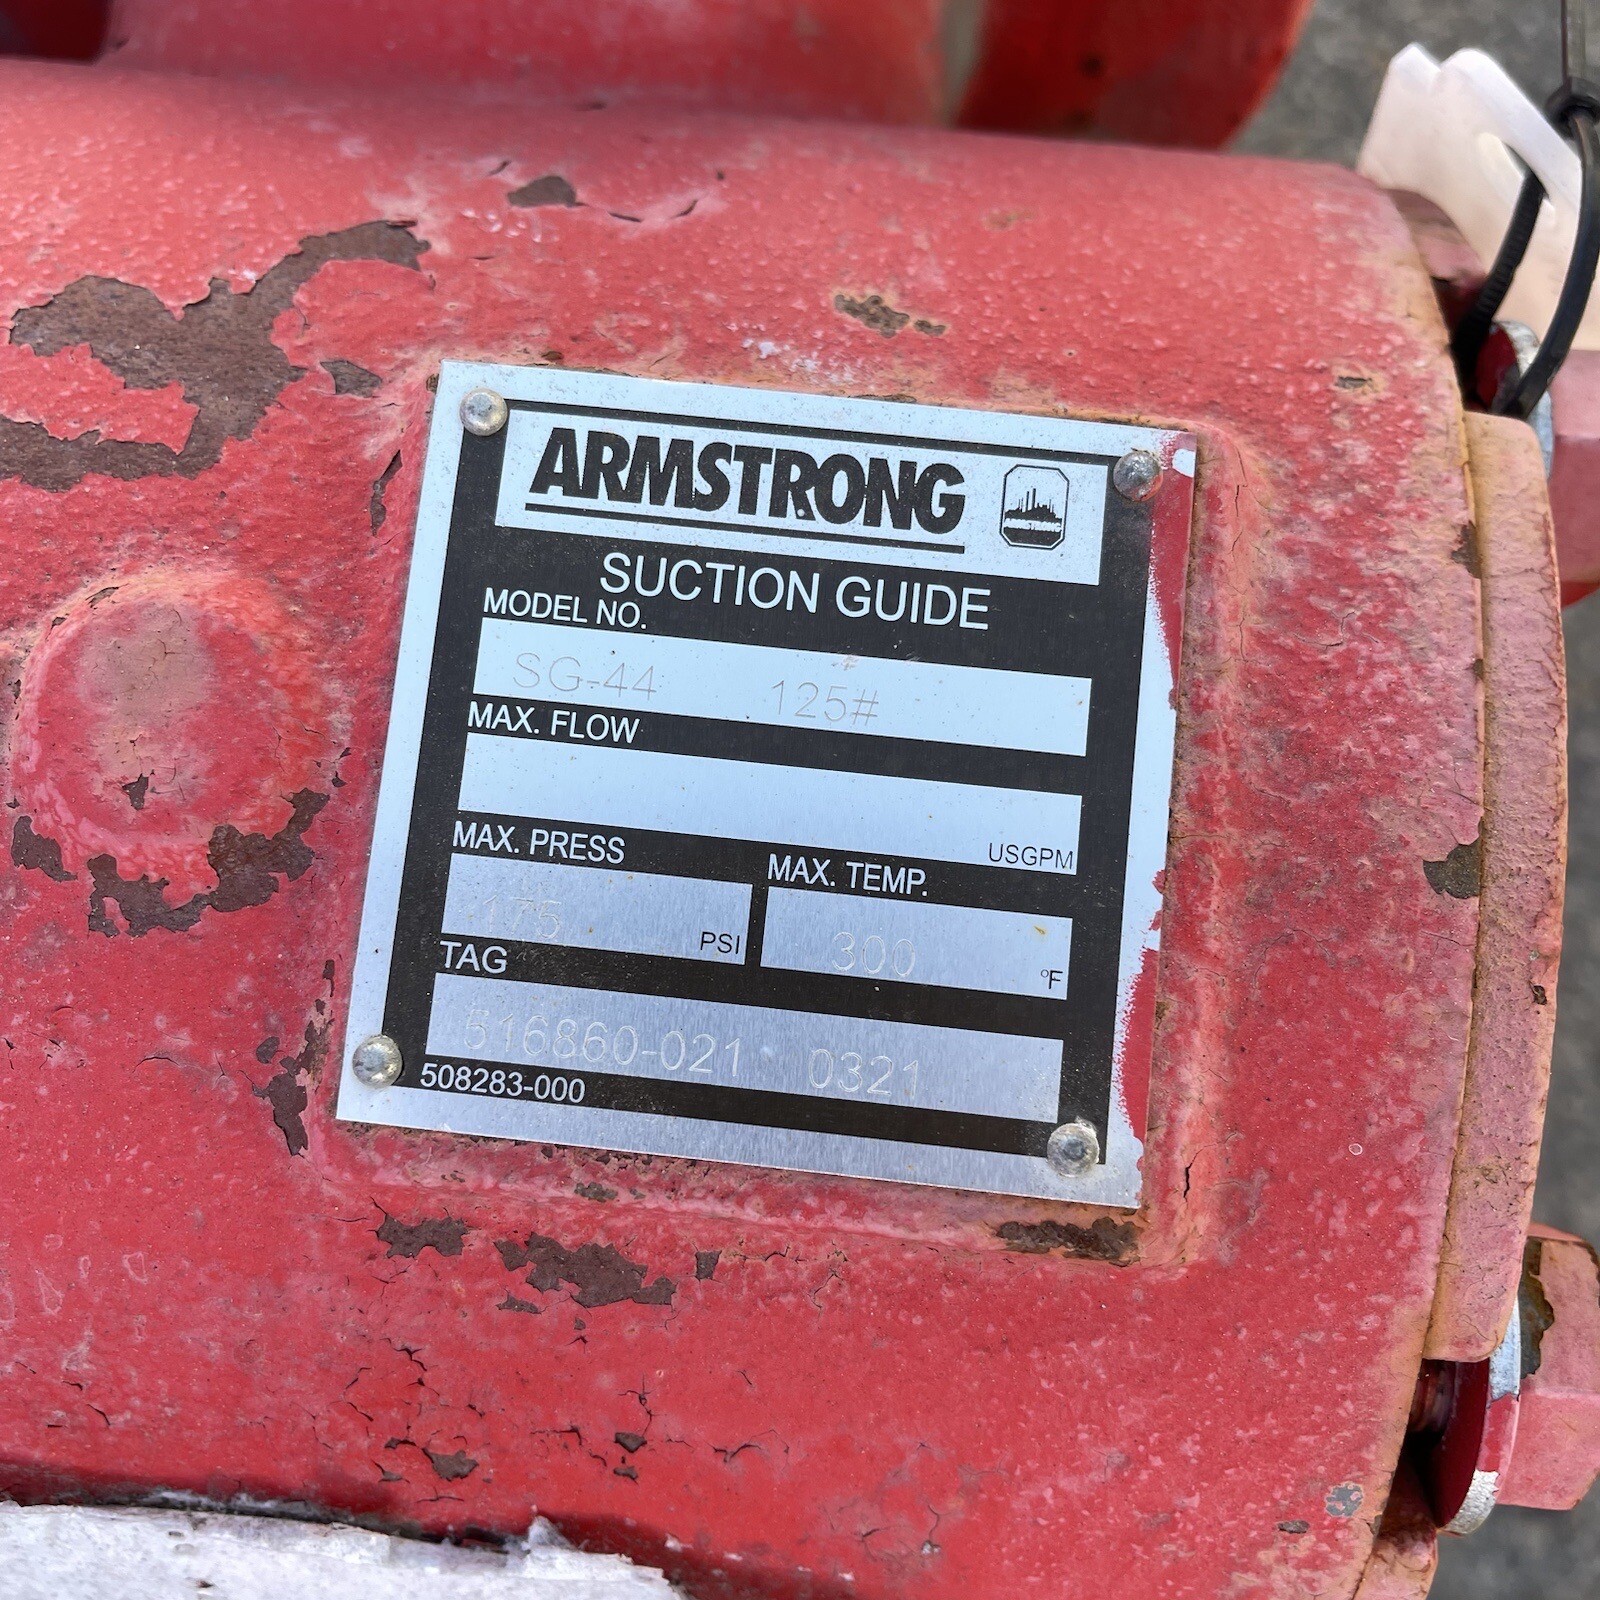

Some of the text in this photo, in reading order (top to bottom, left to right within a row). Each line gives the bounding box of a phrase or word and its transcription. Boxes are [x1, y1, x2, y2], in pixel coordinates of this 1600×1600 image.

[529, 427, 965, 534] ARMSTRONG
[483, 587, 647, 630] MODEL NO.
[600, 552, 991, 631] SUCTION GUIDE
[513, 652, 879, 726] SG-44 125#
[467, 701, 641, 744] MAX. FLOW
[452, 820, 626, 864] MAX. PRESS
[988, 842, 1075, 870] USGPM
[767, 853, 928, 897] MAX. TEMP.
[483, 895, 741, 956] 175 PSI
[439, 940, 508, 974] TAG
[831, 931, 916, 977] 300
[463, 1009, 919, 1099] 516860-021 0321
[420, 1062, 586, 1104] 508283-000
